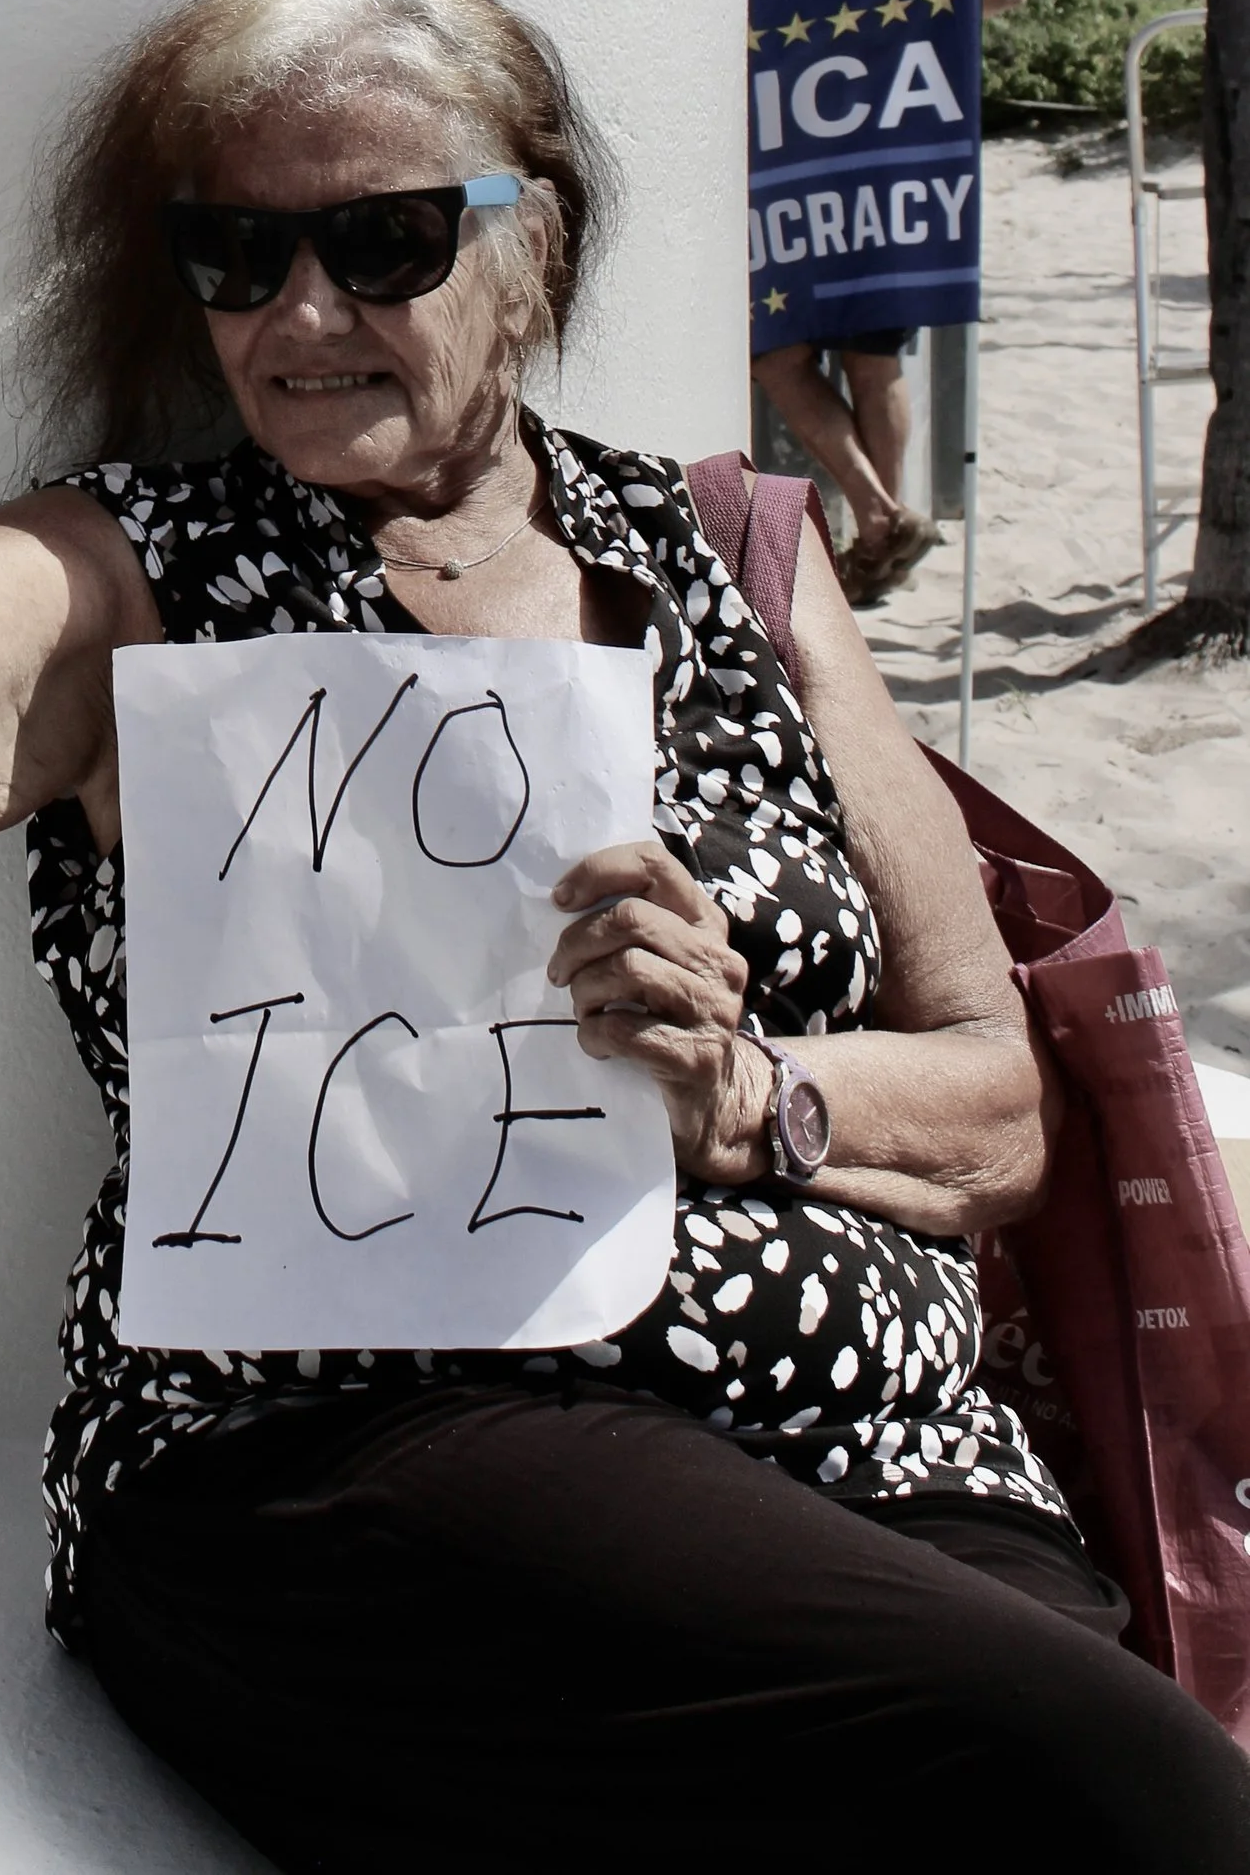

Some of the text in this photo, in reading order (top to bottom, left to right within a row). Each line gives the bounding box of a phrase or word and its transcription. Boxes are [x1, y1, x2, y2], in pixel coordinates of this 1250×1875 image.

[753, 40, 965, 152] ICA
[218, 672, 531, 882] NO
[151, 991, 607, 1249] ICE
